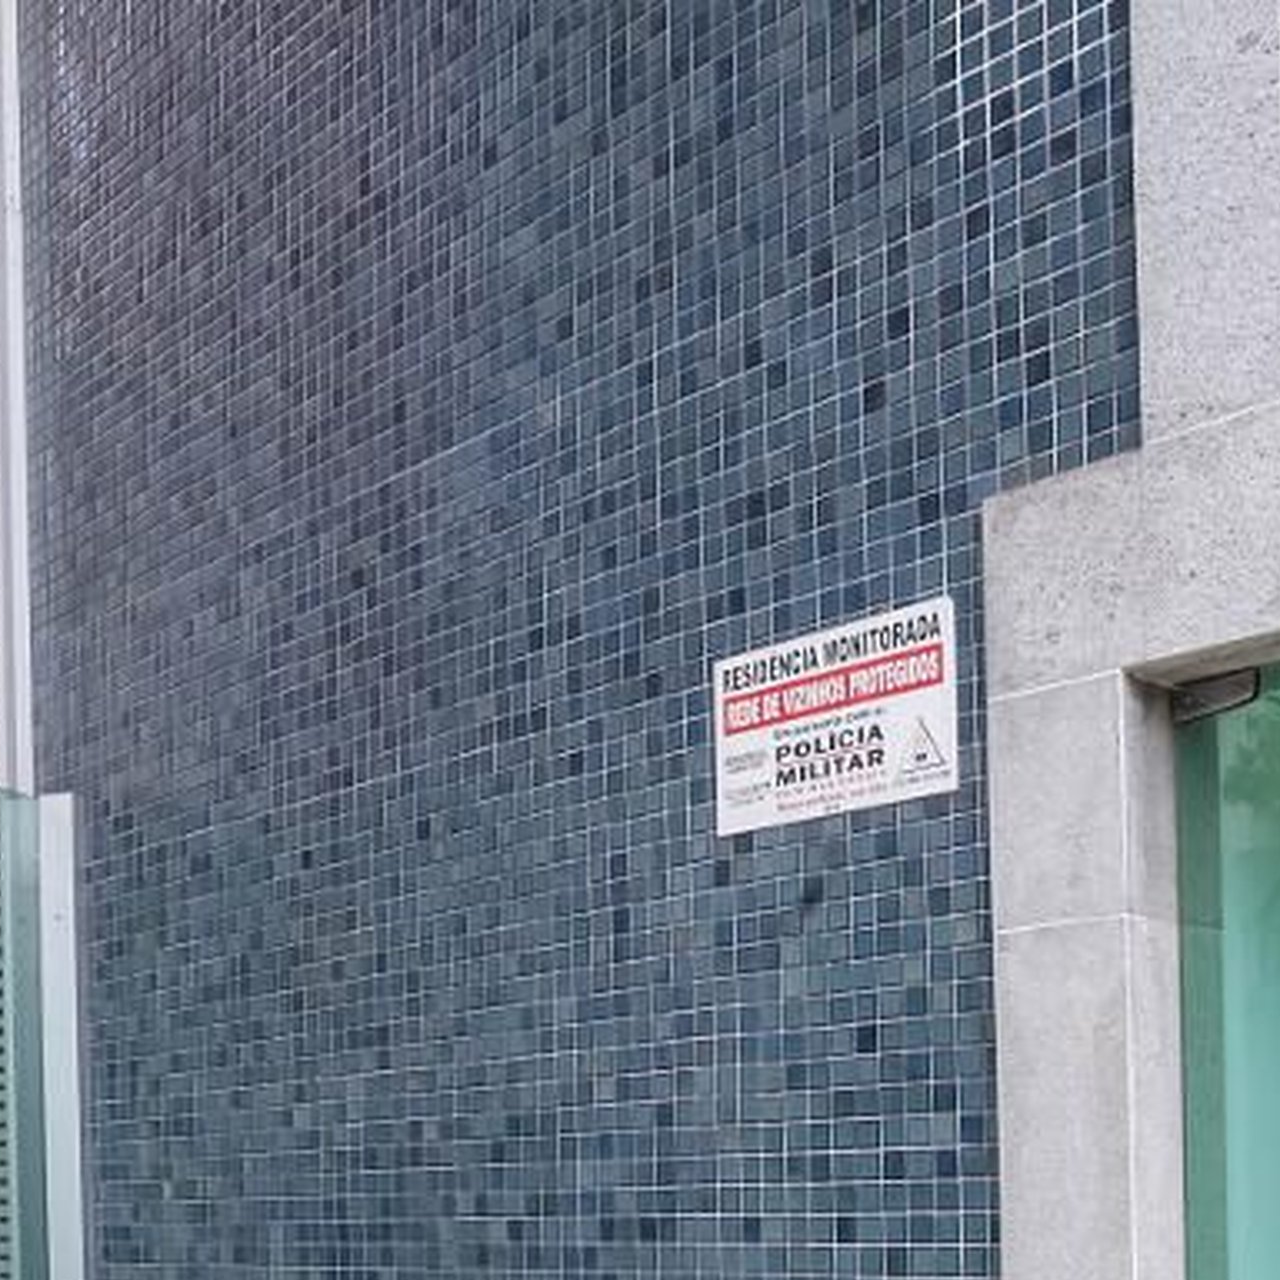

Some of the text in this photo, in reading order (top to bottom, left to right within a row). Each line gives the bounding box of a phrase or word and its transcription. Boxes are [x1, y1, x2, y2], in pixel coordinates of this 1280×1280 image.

[823, 613, 941, 667] MONITORADA
[763, 691, 780, 721] DE
[849, 650, 938, 699] PROTEGIDOS
[775, 750, 886, 787] MILITAR
